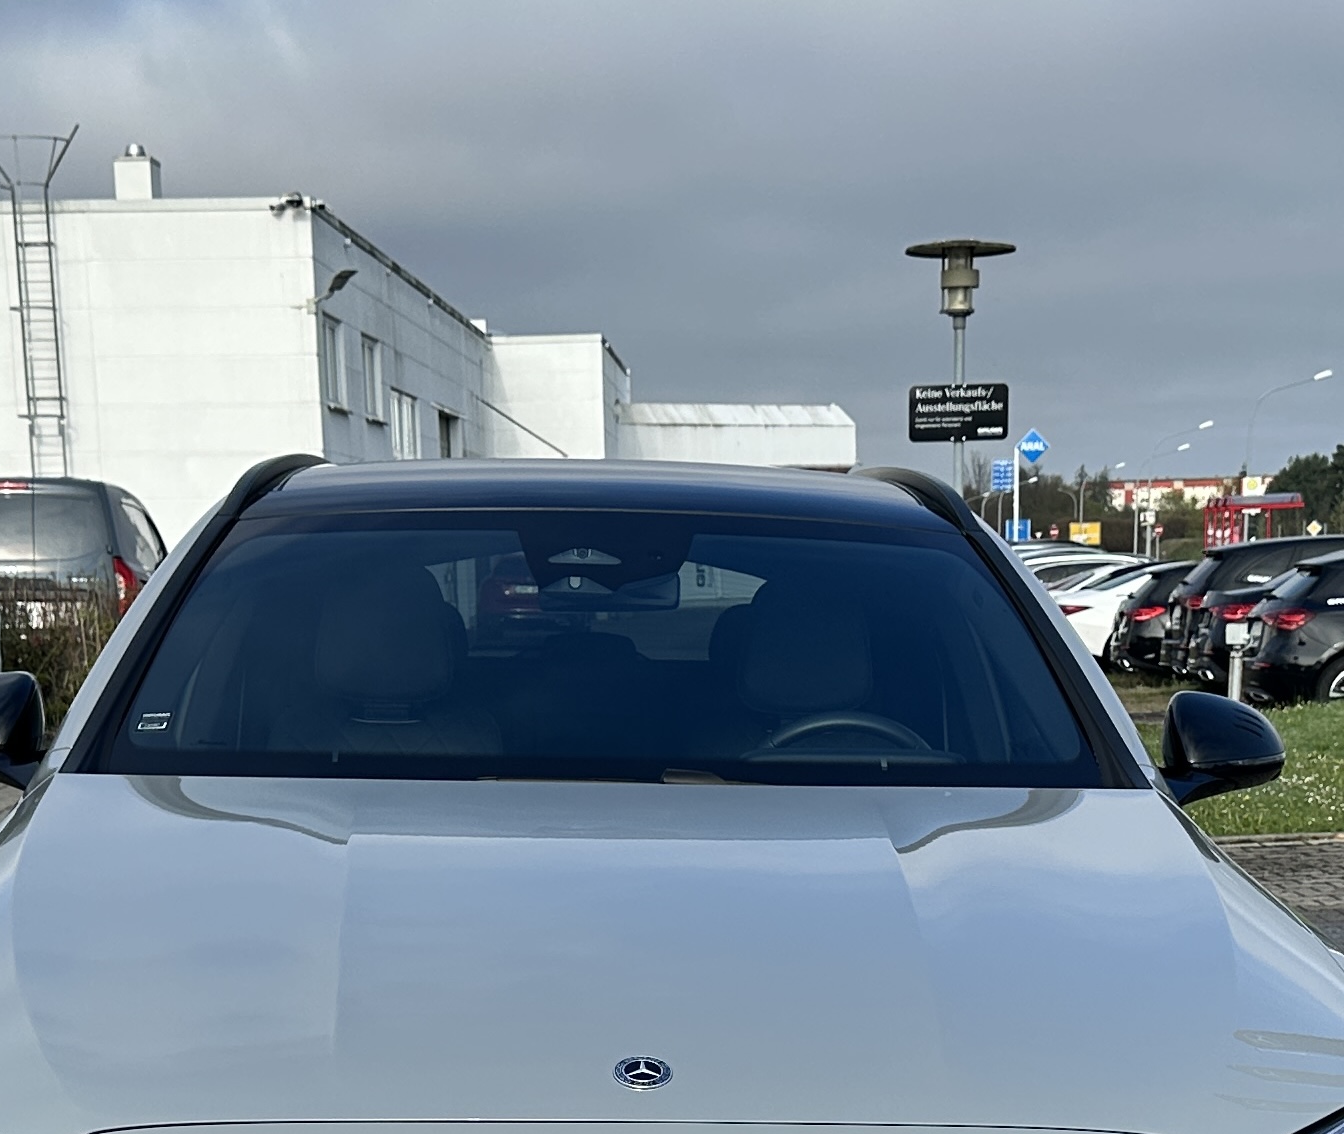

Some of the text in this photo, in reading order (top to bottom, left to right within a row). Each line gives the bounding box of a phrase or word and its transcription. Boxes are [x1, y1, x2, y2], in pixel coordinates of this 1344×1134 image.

[915, 388, 943, 399] Keine
[915, 400, 1003, 413] Ausstellungsfläche
[1020, 441, 1045, 451] ARAL
